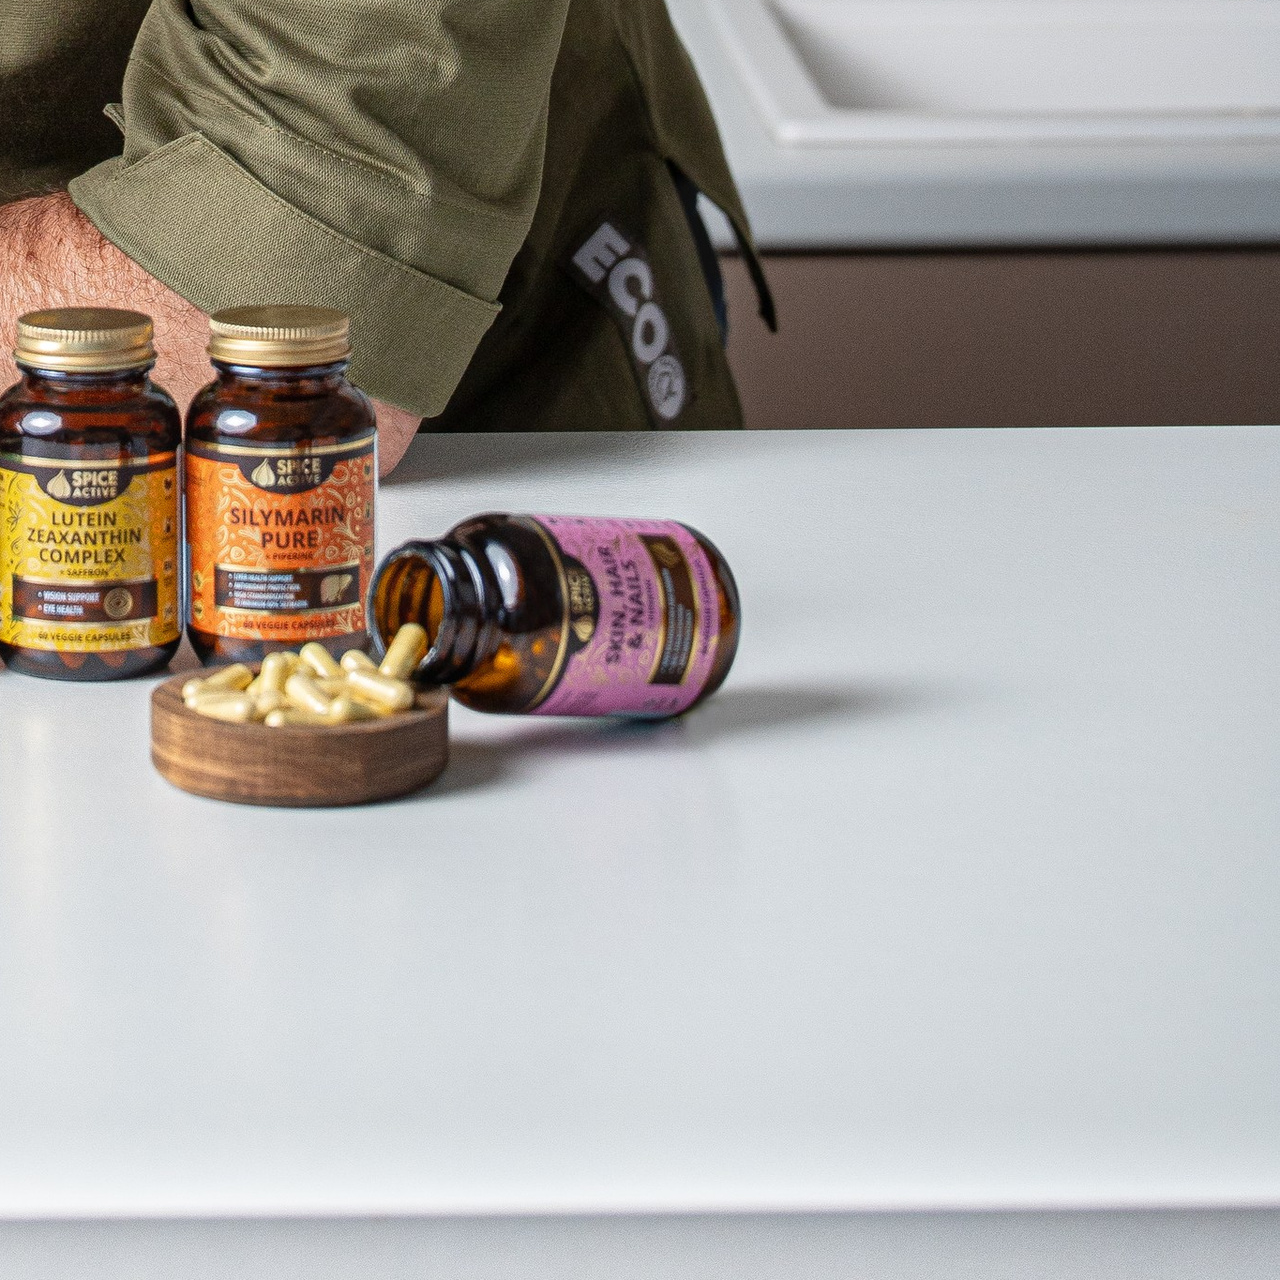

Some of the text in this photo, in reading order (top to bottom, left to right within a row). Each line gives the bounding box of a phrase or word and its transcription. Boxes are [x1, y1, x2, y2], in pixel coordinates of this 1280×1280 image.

[572, 221, 669, 365] ECO
[72, 470, 118, 487] SPICE
[72, 487, 118, 499] ACTIVE
[52, 511, 117, 527] LUTEIN
[231, 507, 344, 526] SILYMARIN
[27, 527, 142, 545] ZEAXANTHIN
[261, 530, 319, 548] PURE
[39, 549, 126, 564] COMPLEX
[67, 567, 109, 576] SAFFRON
[597, 546, 624, 598] HAIR
[622, 559, 644, 650] & NAILS
[255, 621, 288, 629] VEGGIE
[51, 632, 82, 641] VEGGIE
[84, 630, 131, 642] CAPSULES
